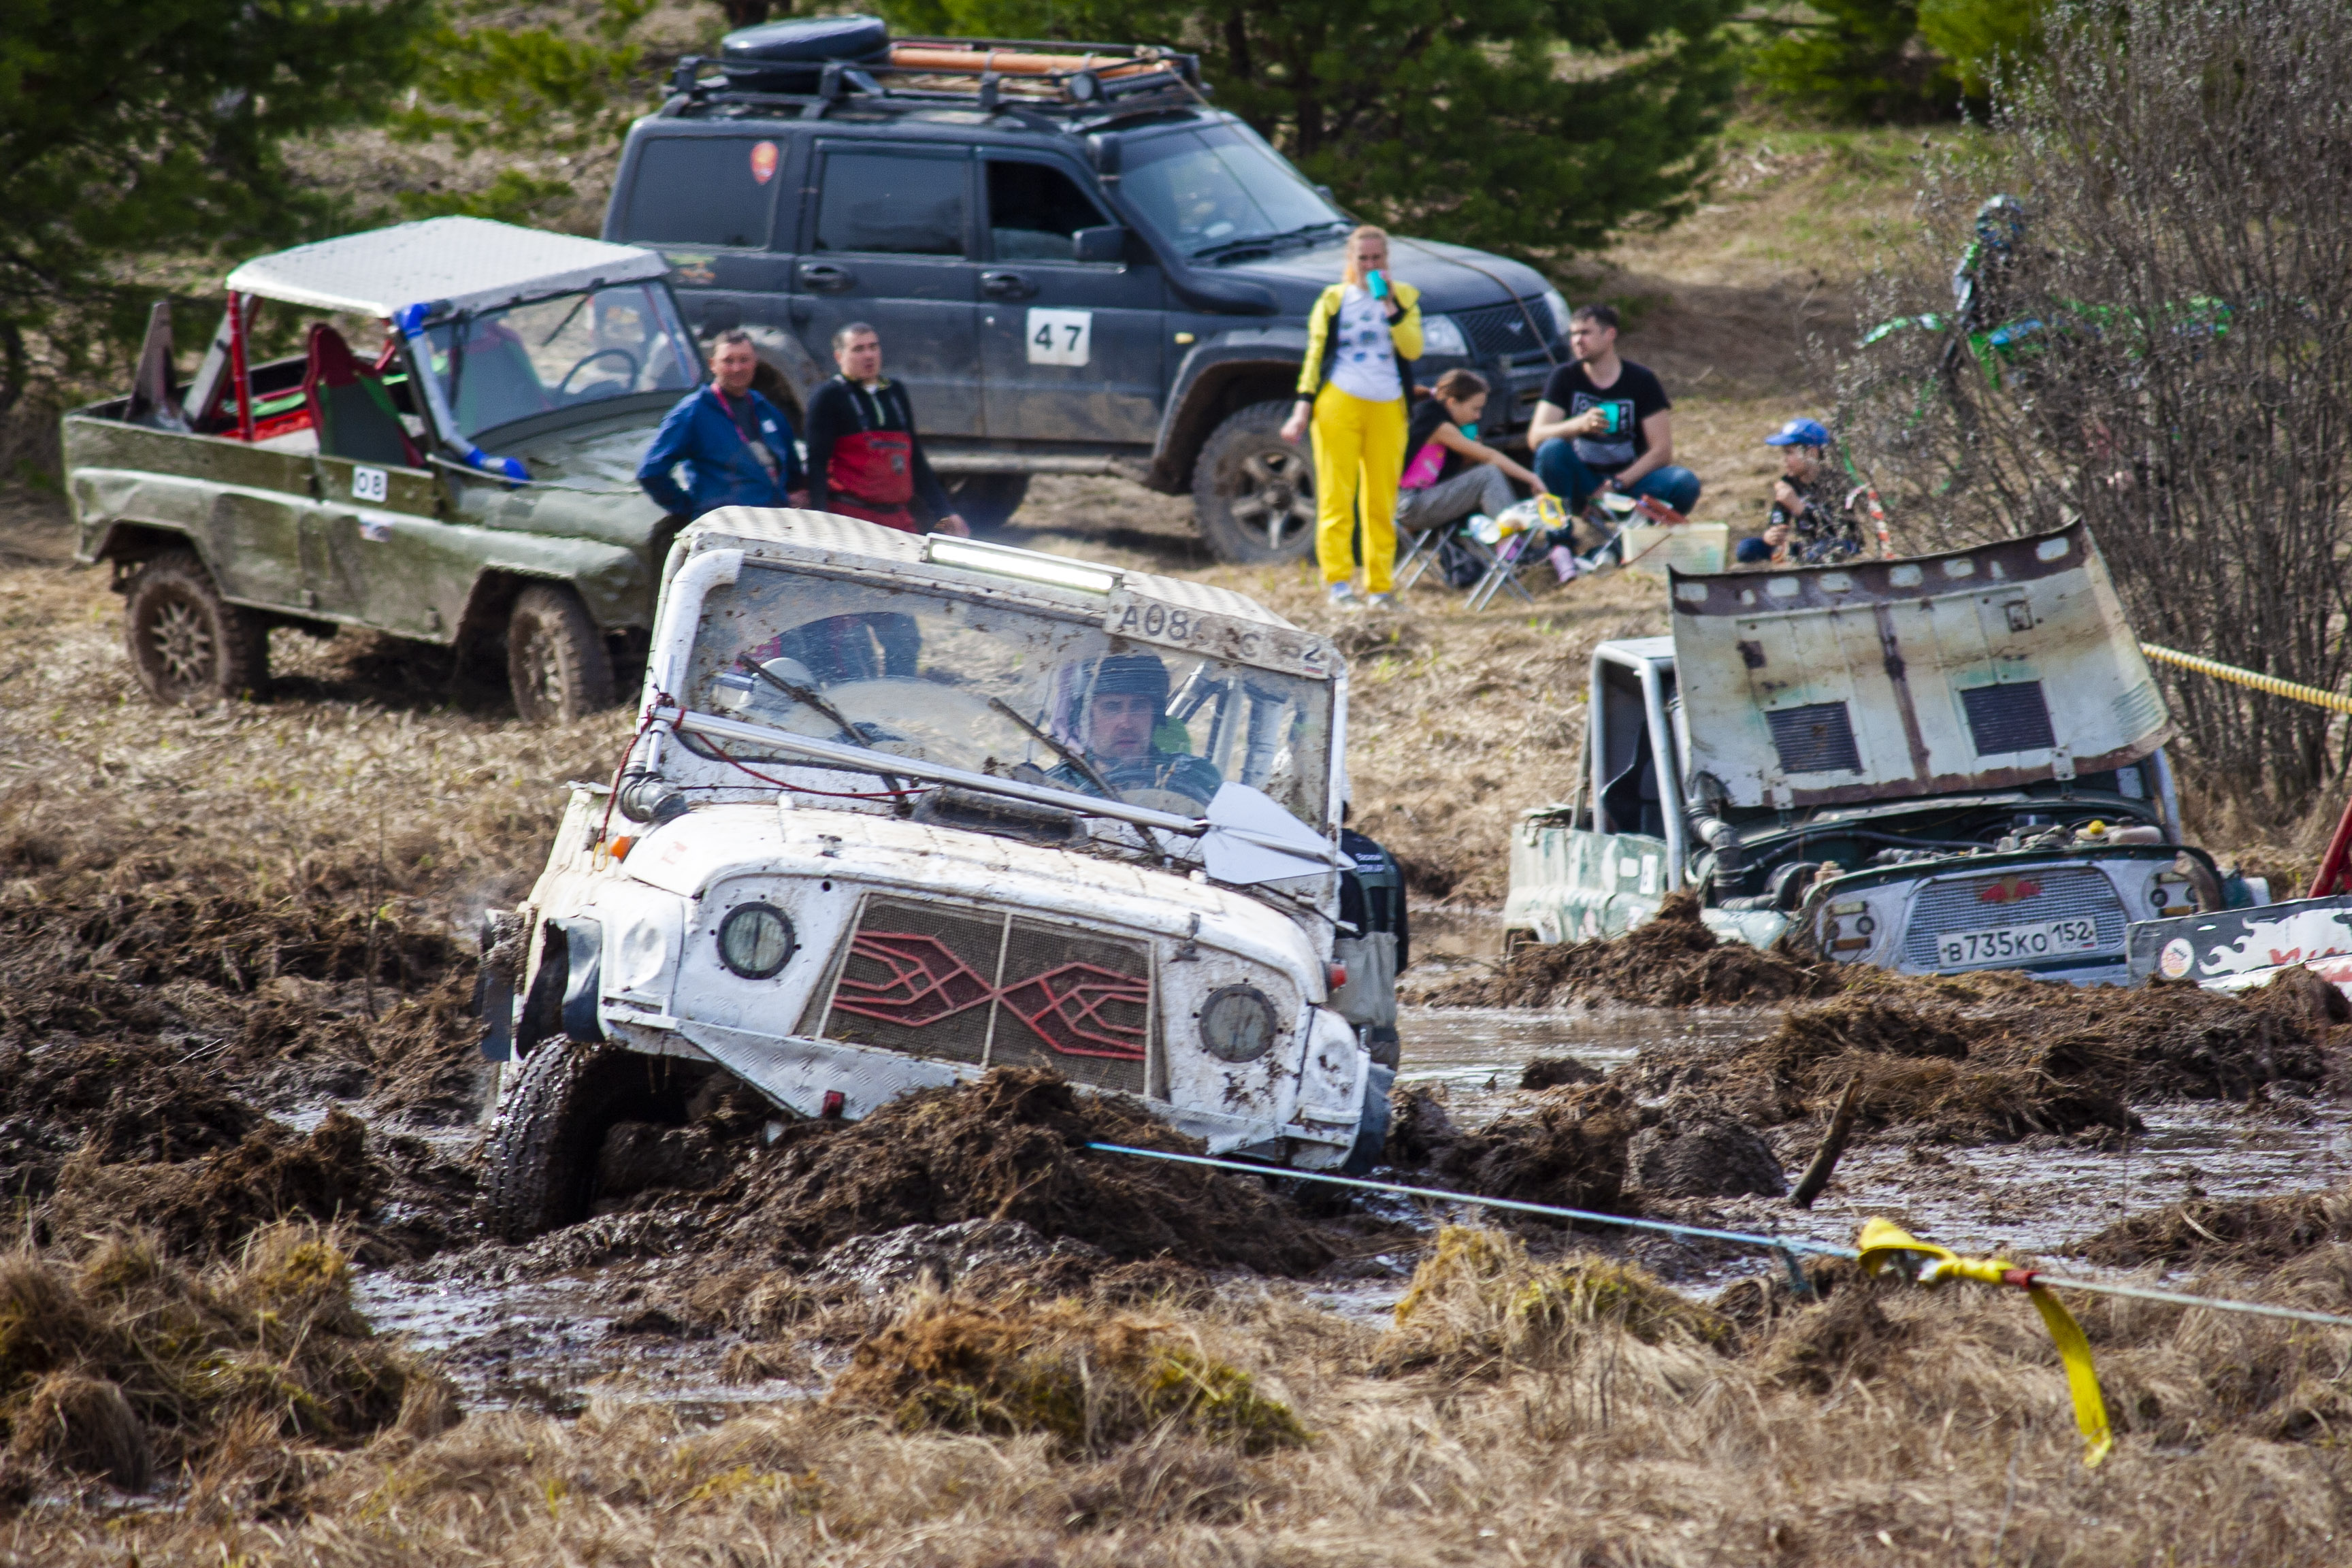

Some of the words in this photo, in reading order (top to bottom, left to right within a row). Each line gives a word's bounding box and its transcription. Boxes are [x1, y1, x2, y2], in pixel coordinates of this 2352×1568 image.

[1034, 323, 1082, 352] 47
[358, 472, 382, 495] 08
[2051, 921, 2089, 943] 152
